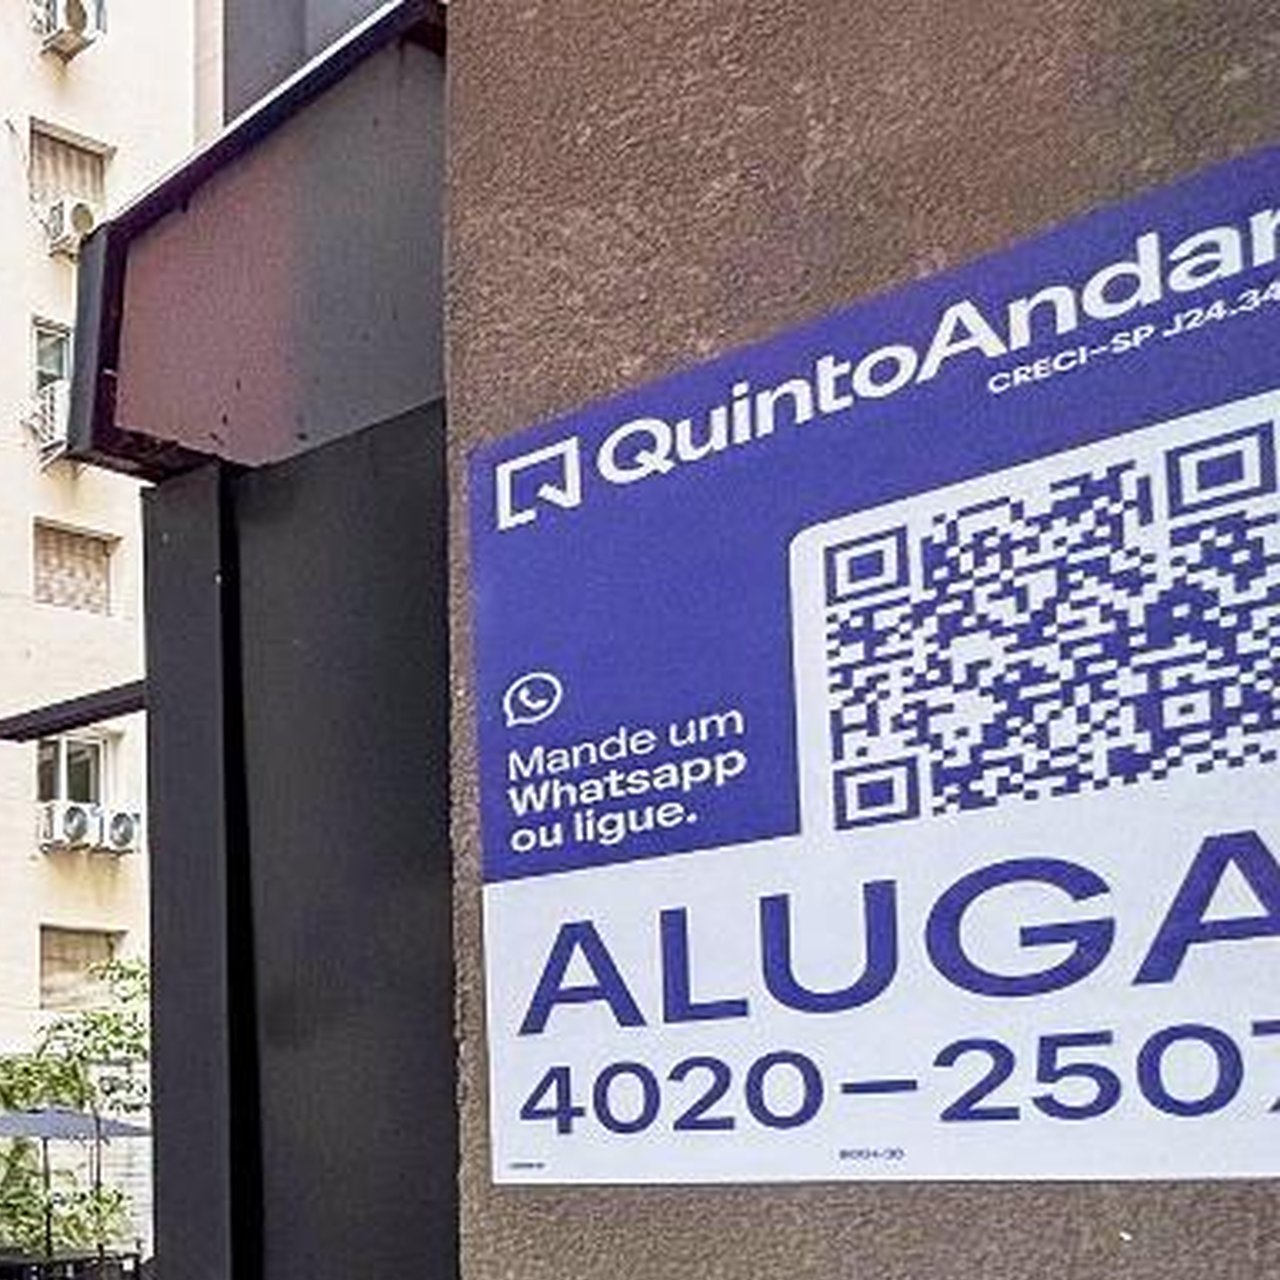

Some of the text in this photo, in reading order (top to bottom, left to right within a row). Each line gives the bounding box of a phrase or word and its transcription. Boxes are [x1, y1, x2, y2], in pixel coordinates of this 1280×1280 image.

[596, 206, 1280, 484] QuintoAndar
[507, 708, 746, 780] Mande um
[507, 746, 748, 817] Whatsapp
[509, 800, 698, 854] ou ligue.
[517, 829, 1280, 1037] ALUGA
